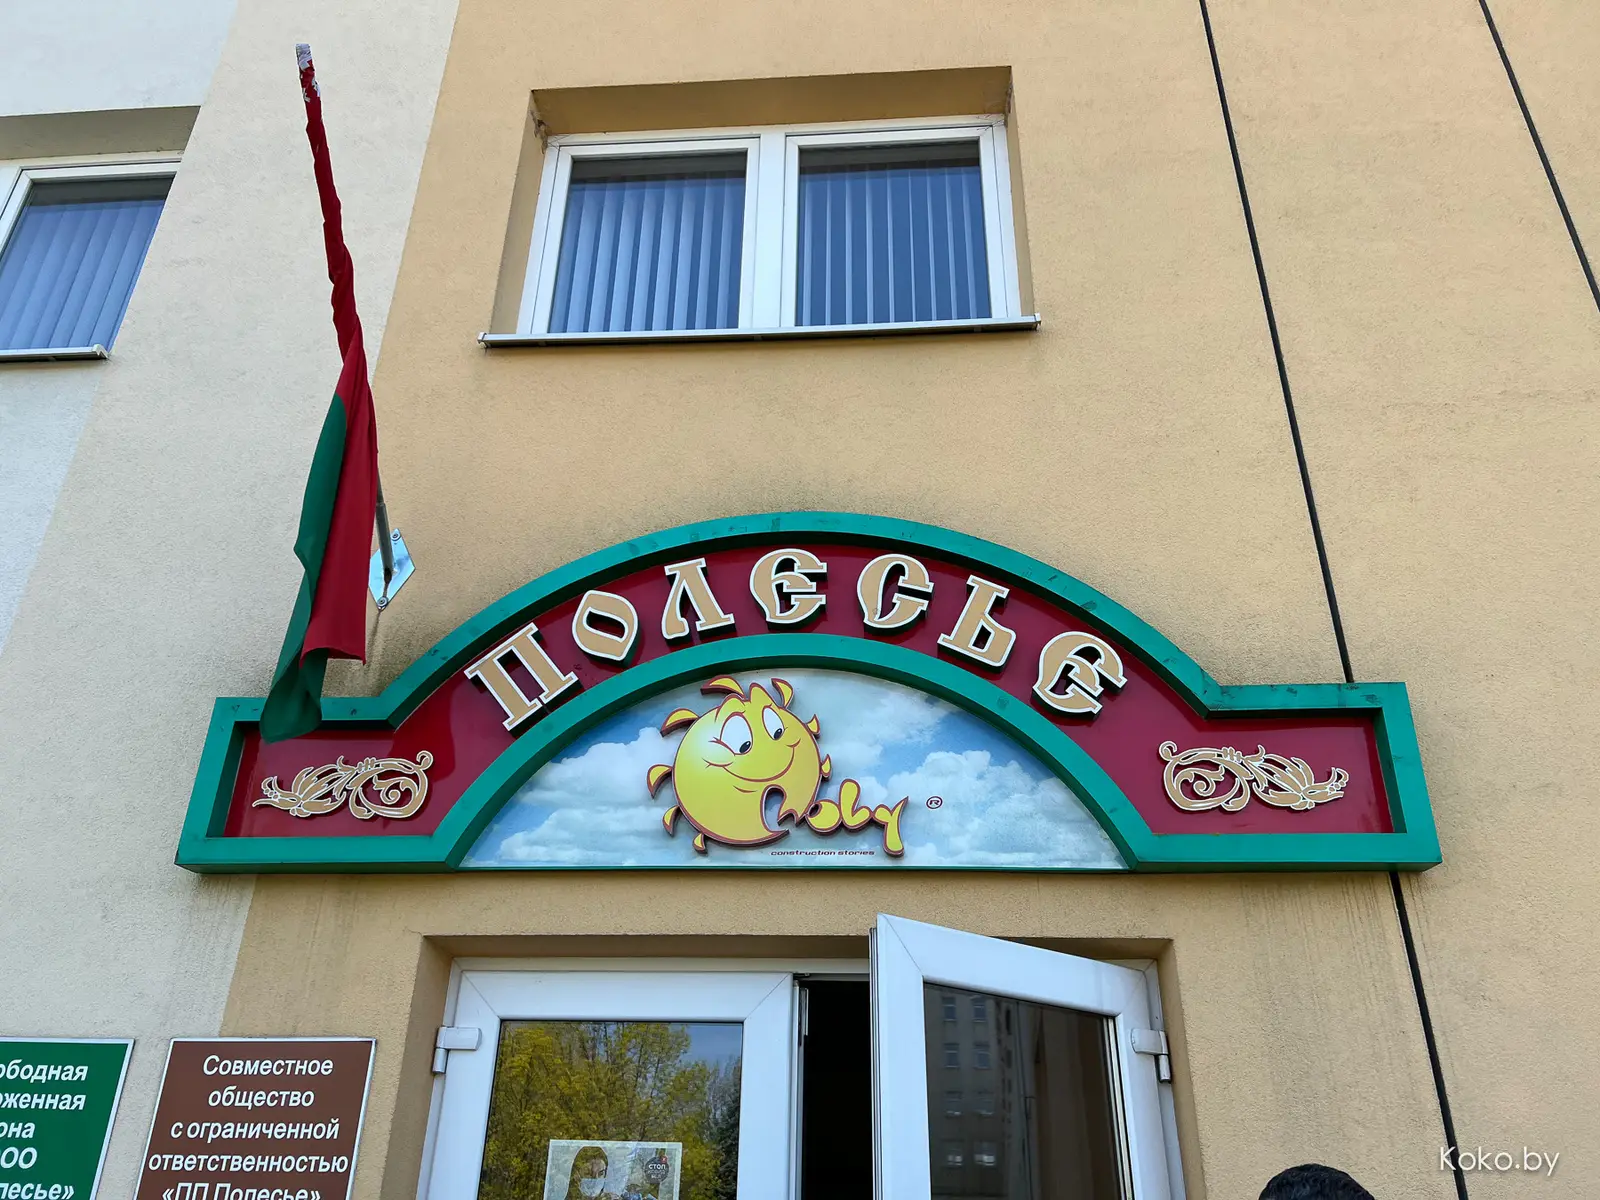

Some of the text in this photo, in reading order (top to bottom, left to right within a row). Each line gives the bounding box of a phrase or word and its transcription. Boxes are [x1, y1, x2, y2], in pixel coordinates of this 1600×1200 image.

[463, 547, 1128, 733] ПОЛЕСЬЕ
[202, 1054, 334, 1076] Совместное
[0, 1092, 87, 1110] женная
[208, 1085, 315, 1110] общество
[170, 1118, 340, 1144] с ограниченной
[148, 1153, 349, 1173] ответственностью
